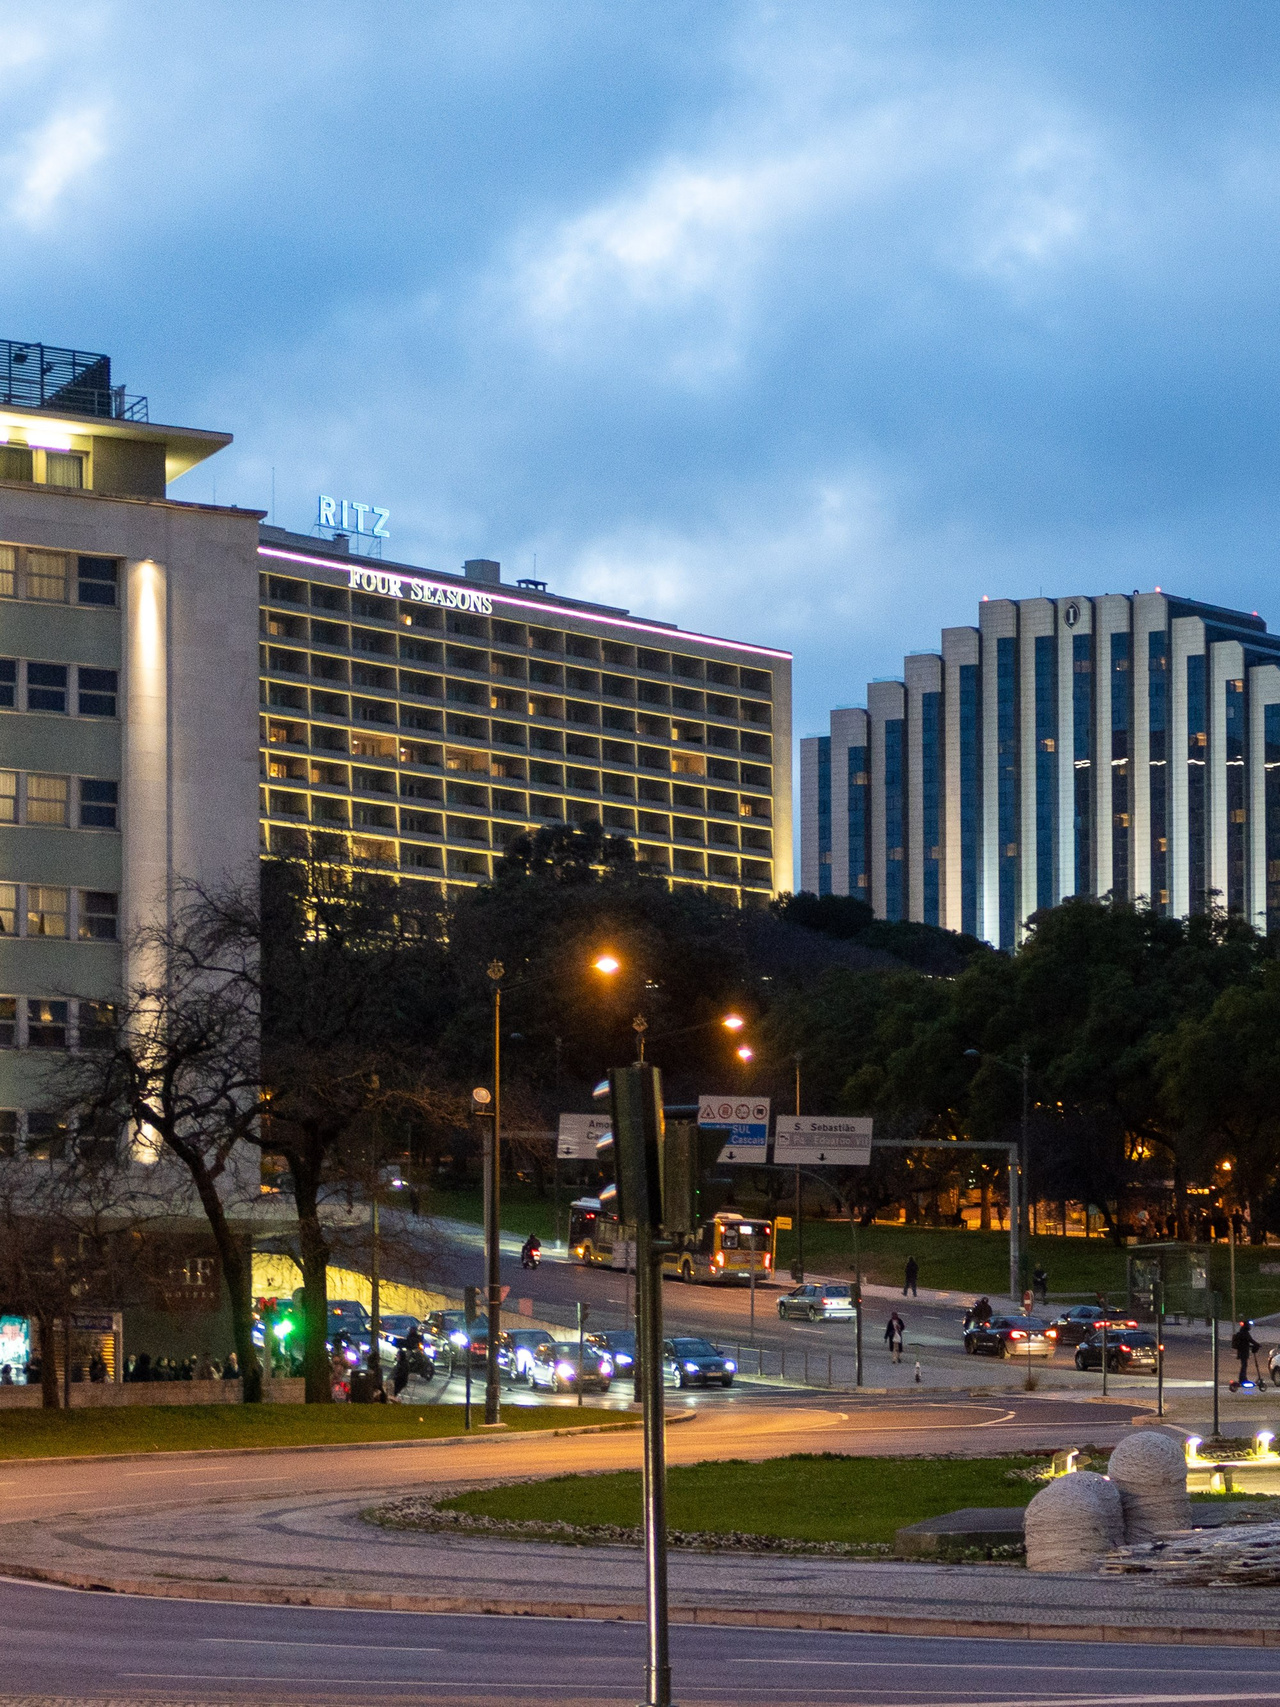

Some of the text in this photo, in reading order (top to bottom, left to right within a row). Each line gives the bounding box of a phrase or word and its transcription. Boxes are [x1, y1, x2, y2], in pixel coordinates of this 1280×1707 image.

[319, 495, 390, 537] RITZ
[348, 565, 493, 615] FOUR SEASONS
[732, 1124, 751, 1134] SUL
[794, 1122, 856, 1132] S. Sebastião
[731, 1135, 765, 1144] Cascais
